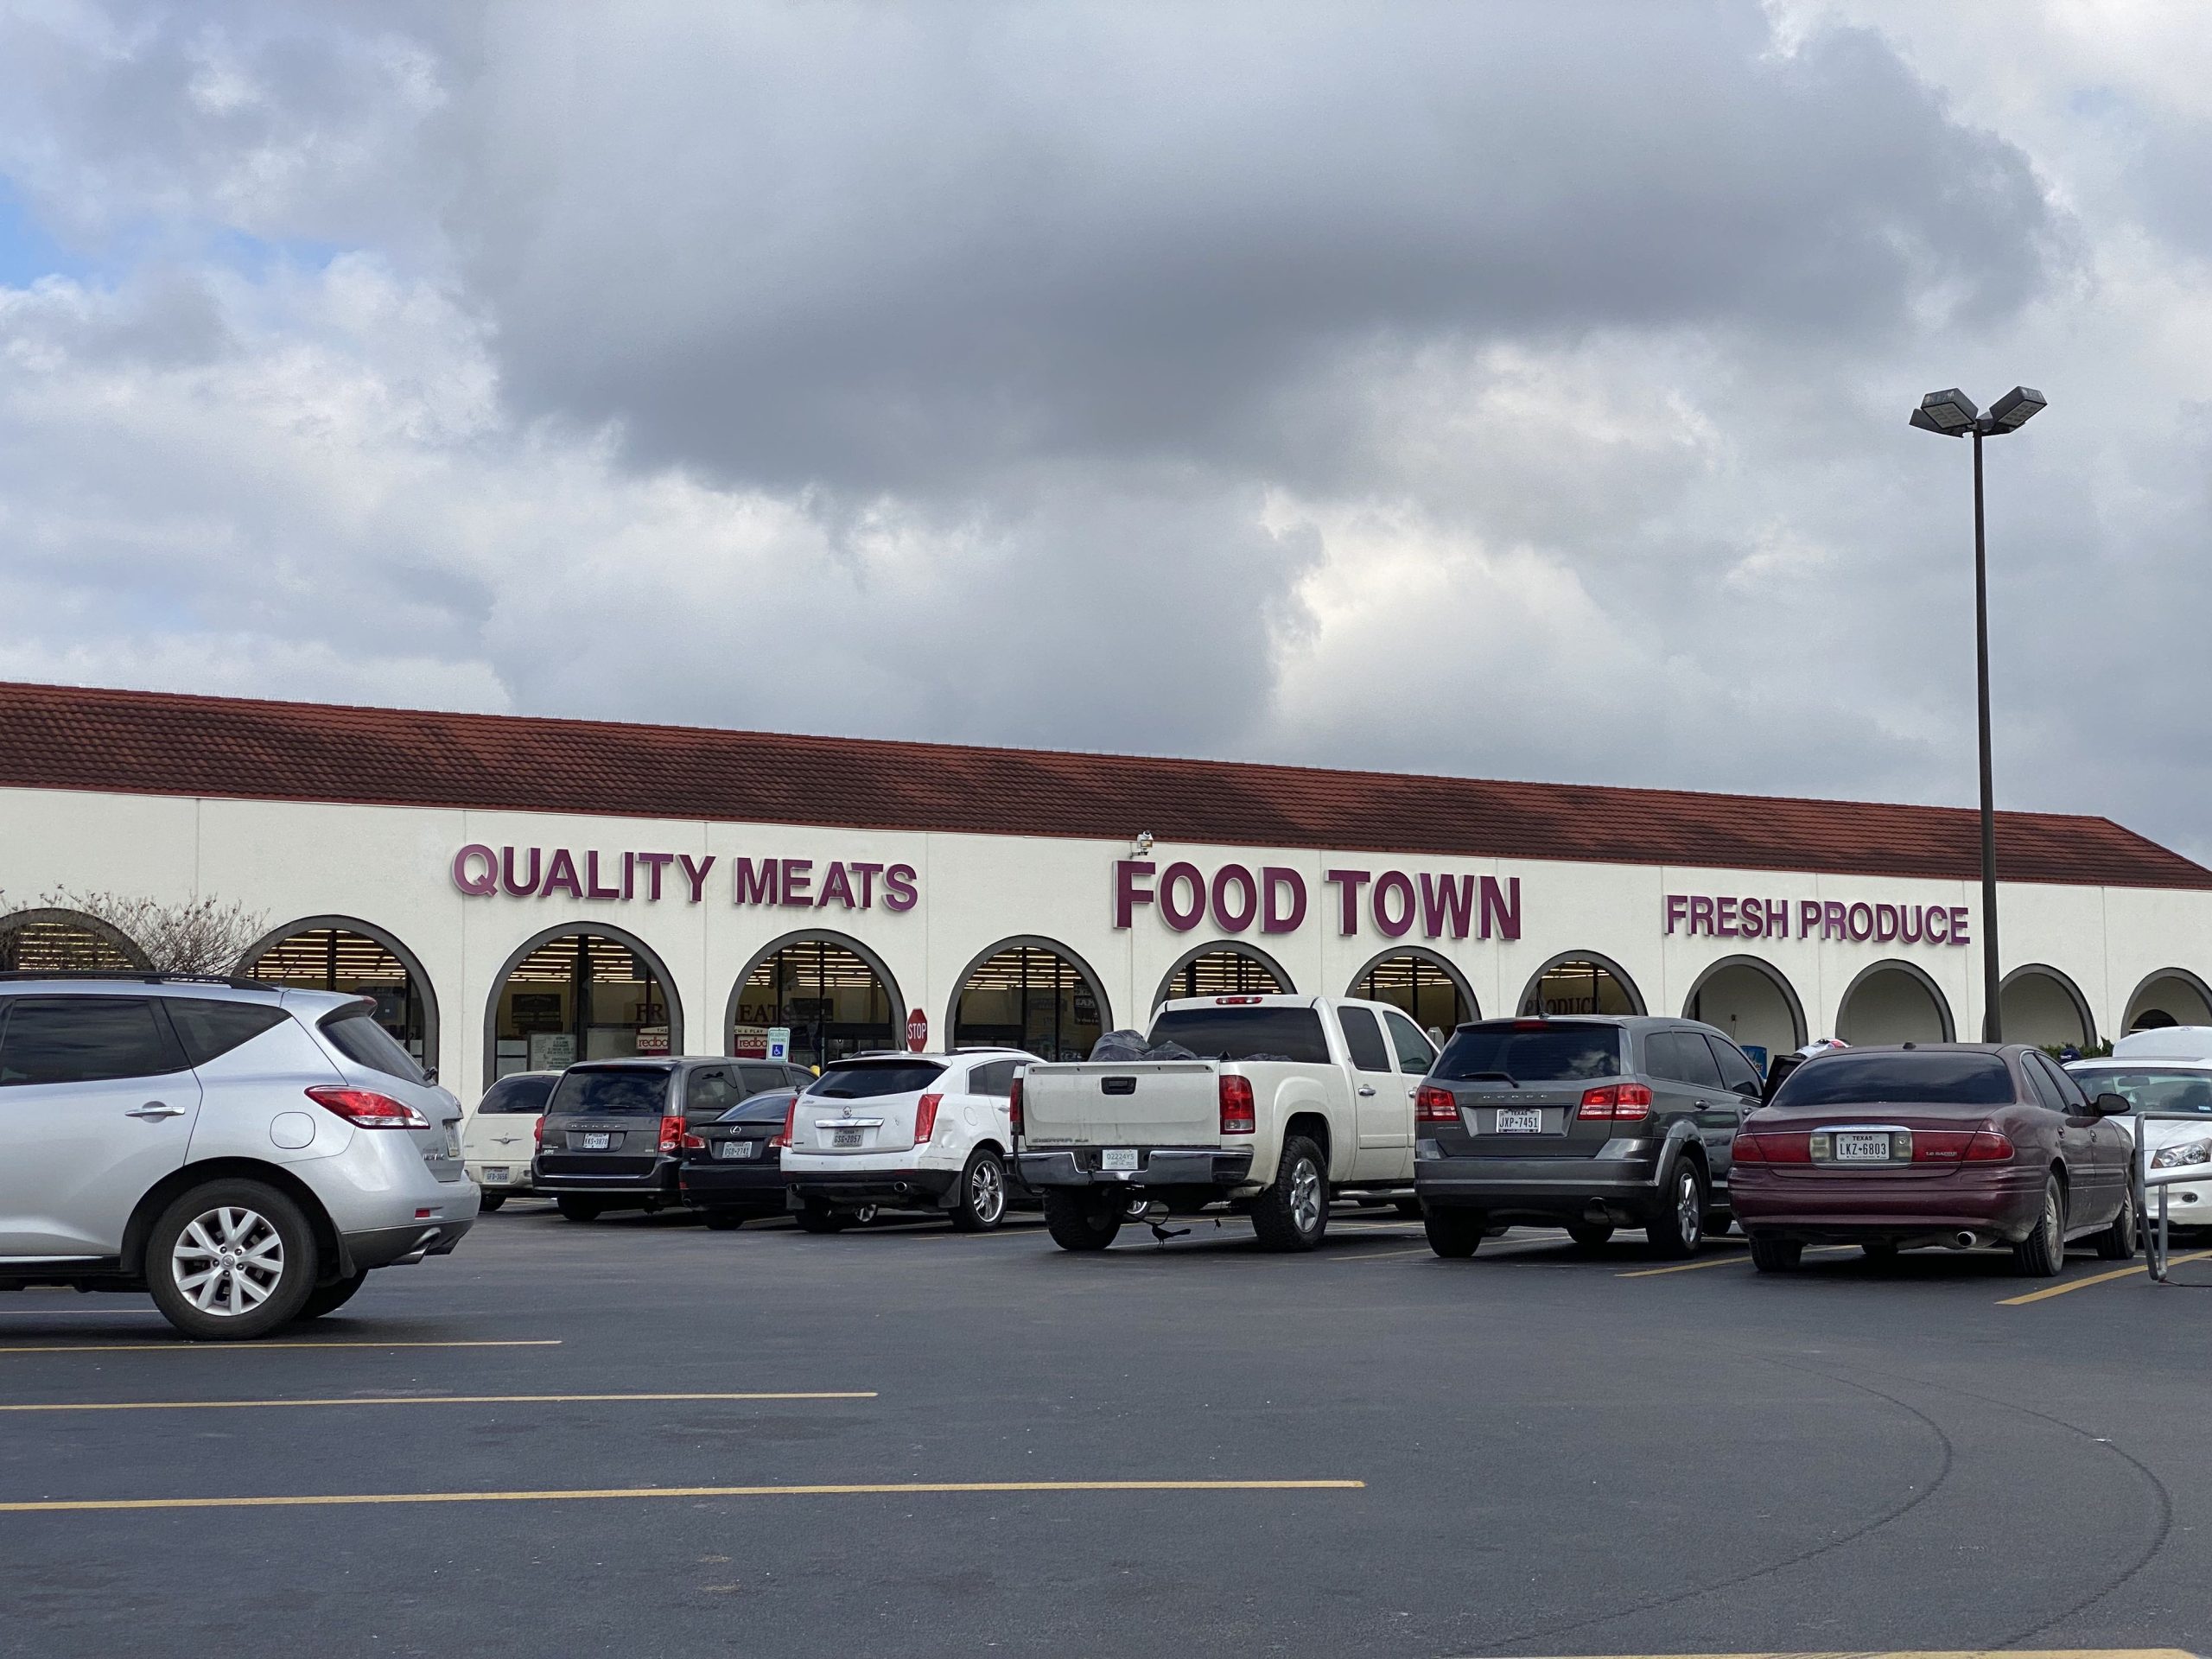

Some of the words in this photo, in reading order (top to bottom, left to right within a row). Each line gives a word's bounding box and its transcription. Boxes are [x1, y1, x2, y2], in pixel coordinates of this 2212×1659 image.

[452, 843, 717, 903] QUALITY
[734, 857, 918, 912] MEATS
[1113, 860, 1307, 933] FOOD
[1325, 868, 1522, 941] TOWN
[1663, 893, 1789, 938] FRESH
[1796, 899, 1971, 945] PRODUCE
[908, 1022, 927, 1039] STOP
